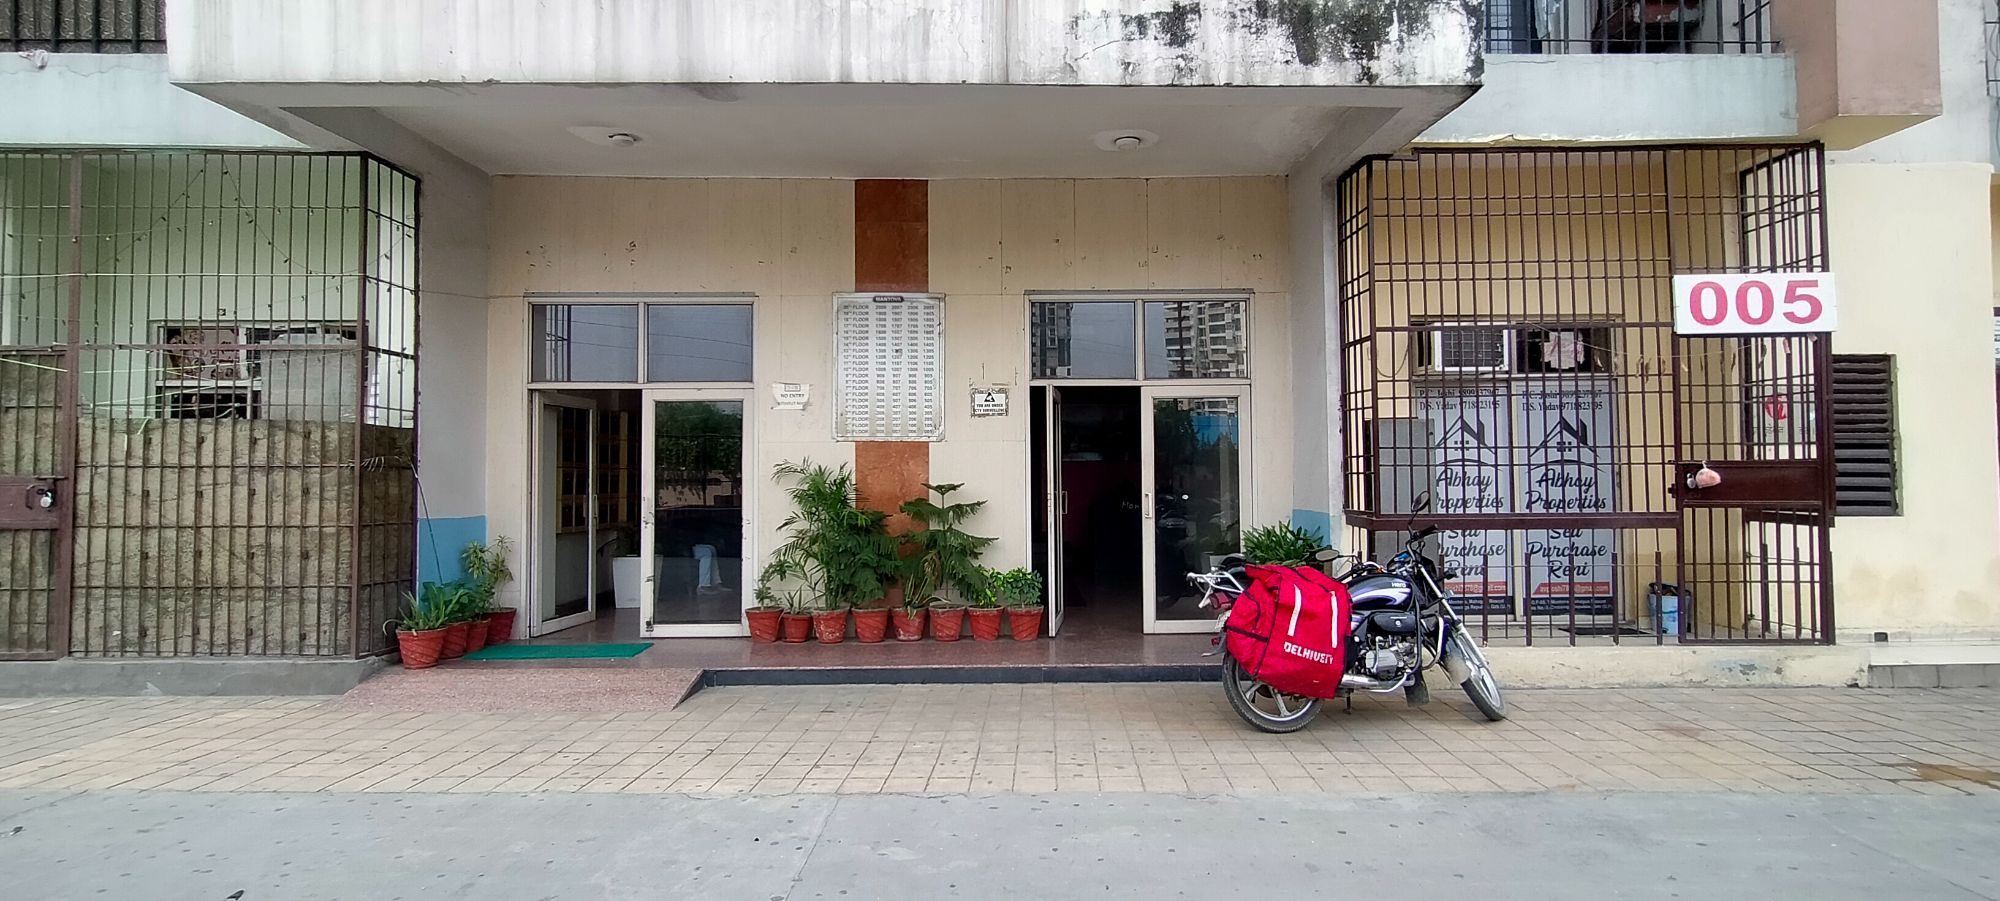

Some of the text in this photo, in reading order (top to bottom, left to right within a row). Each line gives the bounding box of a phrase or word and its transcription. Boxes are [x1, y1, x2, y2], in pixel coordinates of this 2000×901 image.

[1690, 279, 1822, 326] 005
[1459, 400, 1500, 410] 7182315
[1436, 468, 1492, 493] Abhay
[1536, 468, 1595, 494] Abhay
[1436, 494, 1504, 513] roperties
[1525, 490, 1607, 513] Properties
[1528, 541, 1608, 558] Purchase
